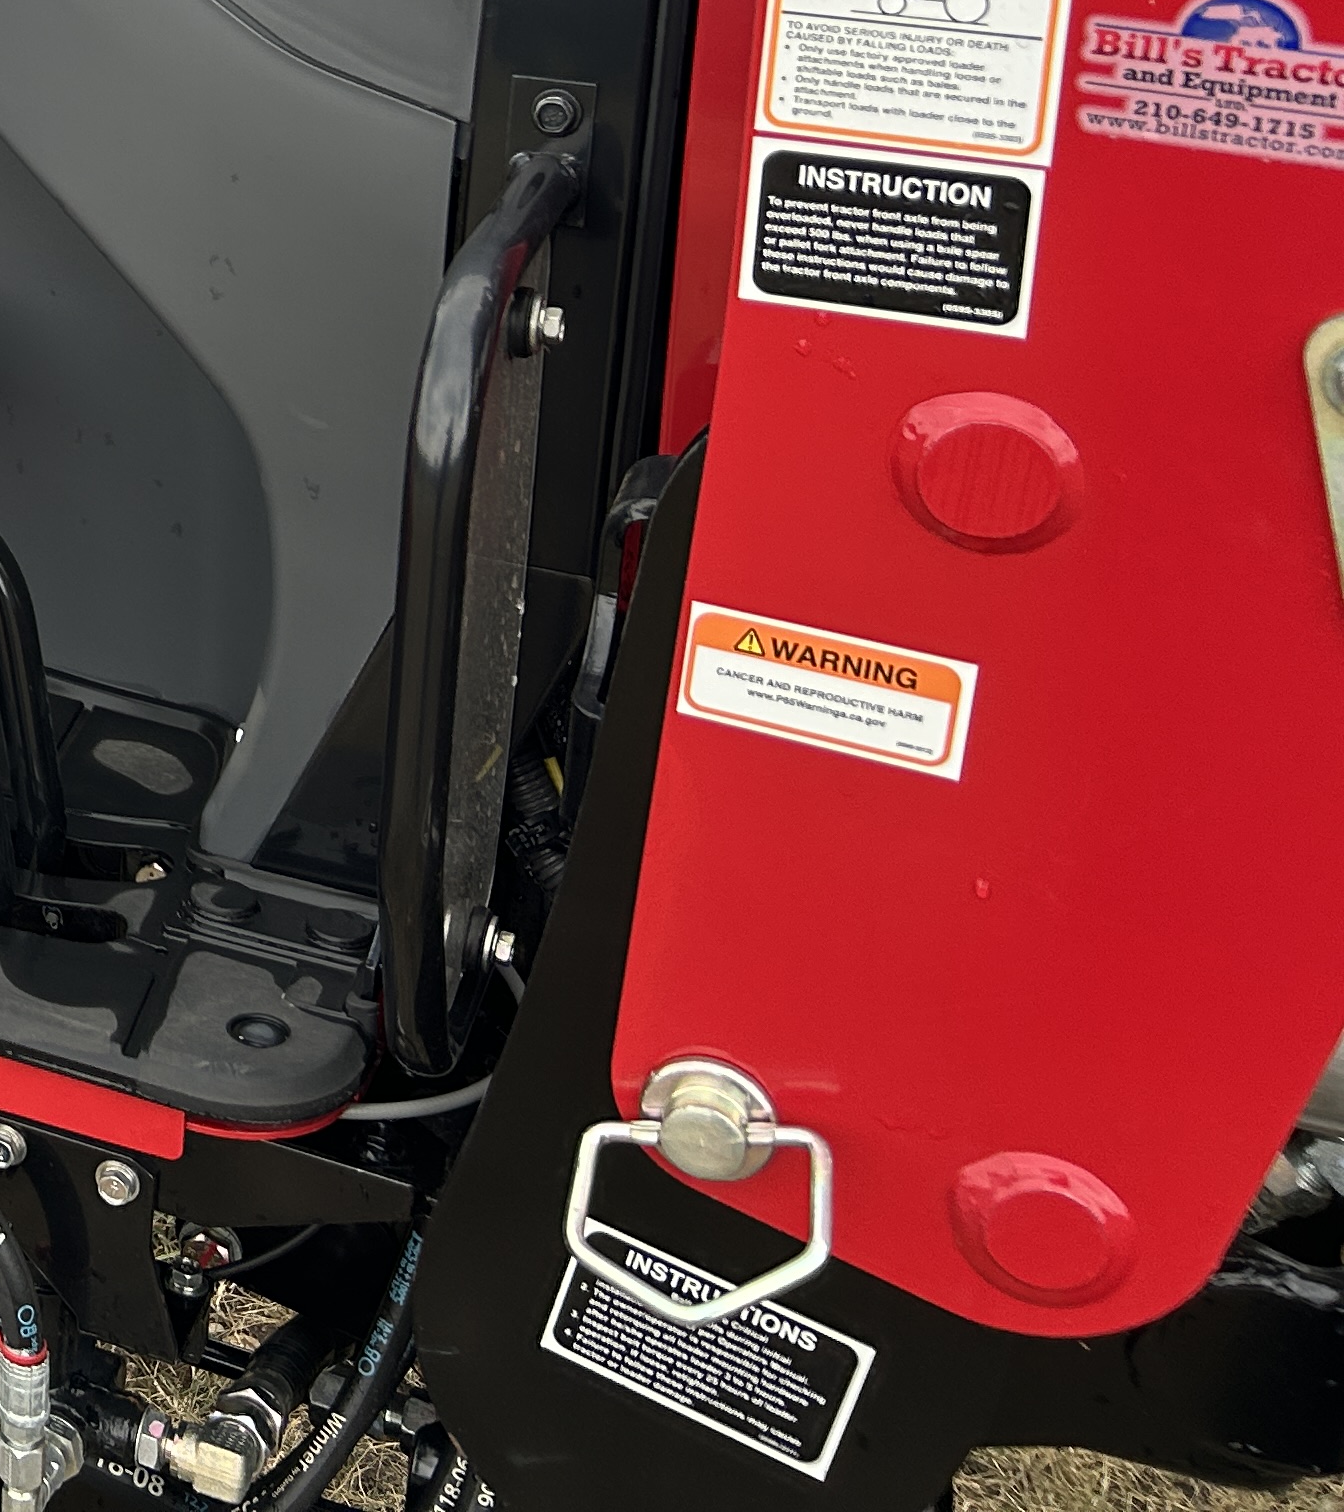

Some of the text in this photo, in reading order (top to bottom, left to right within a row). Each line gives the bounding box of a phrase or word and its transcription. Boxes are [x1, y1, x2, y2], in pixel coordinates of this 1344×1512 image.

[785, 30, 834, 43] CAUSED
[837, 36, 852, 45] BY
[855, 38, 906, 52] FALLING
[786, 19, 1008, 52] TO AVOID SERIOUS INJURY OR DEATH
[798, 43, 824, 54] Only
[849, 49, 888, 62] factory
[892, 54, 945, 68] approved
[1091, 29, 1202, 68] Bill's
[794, 74, 820, 85] Only
[863, 82, 894, 94] loads
[896, 86, 919, 97] that
[943, 92, 989, 105] secured
[868, 61, 898, 73] when
[900, 65, 951, 79] handling
[879, 73, 907, 84] such
[1123, 68, 1337, 108] and Equipment
[908, 108, 944, 121] loader
[981, 117, 993, 127] to
[996, 119, 1016, 129] the
[1134, 100, 1316, 140] 210-649-1715
[797, 162, 992, 210] INSTRUCTION
[767, 195, 997, 236] To prevent tractor front axle from being
[835, 217, 869, 231] never
[871, 222, 912, 237] handle
[914, 228, 947, 242] loads
[949, 232, 975, 245] that
[763, 234, 777, 246] or
[778, 236, 810, 250] pallet
[813, 241, 837, 254] fork
[910, 254, 951, 270] Failure
[954, 260, 967, 272] to
[969, 262, 1007, 277] follow
[764, 221, 806, 236] exceed
[808, 227, 829, 239] 500
[855, 233, 888, 247] when
[889, 238, 924, 252] using
[926, 243, 934, 253] a
[936, 244, 962, 257] bale
[964, 248, 999, 262] spear
[761, 260, 780, 272] the
[782, 263, 820, 278] tractor
[822, 269, 852, 282] front
[853, 273, 878, 286] axle
[762, 247, 1010, 291] these instructions would cause damage to
[769, 636, 919, 692] WARNING
[716, 666, 923, 724] CANCER AND REPRODUCTIVE HARM
[623, 1249, 819, 1353] INSTRUTIONS
[302, 1411, 346, 1473] Winner
